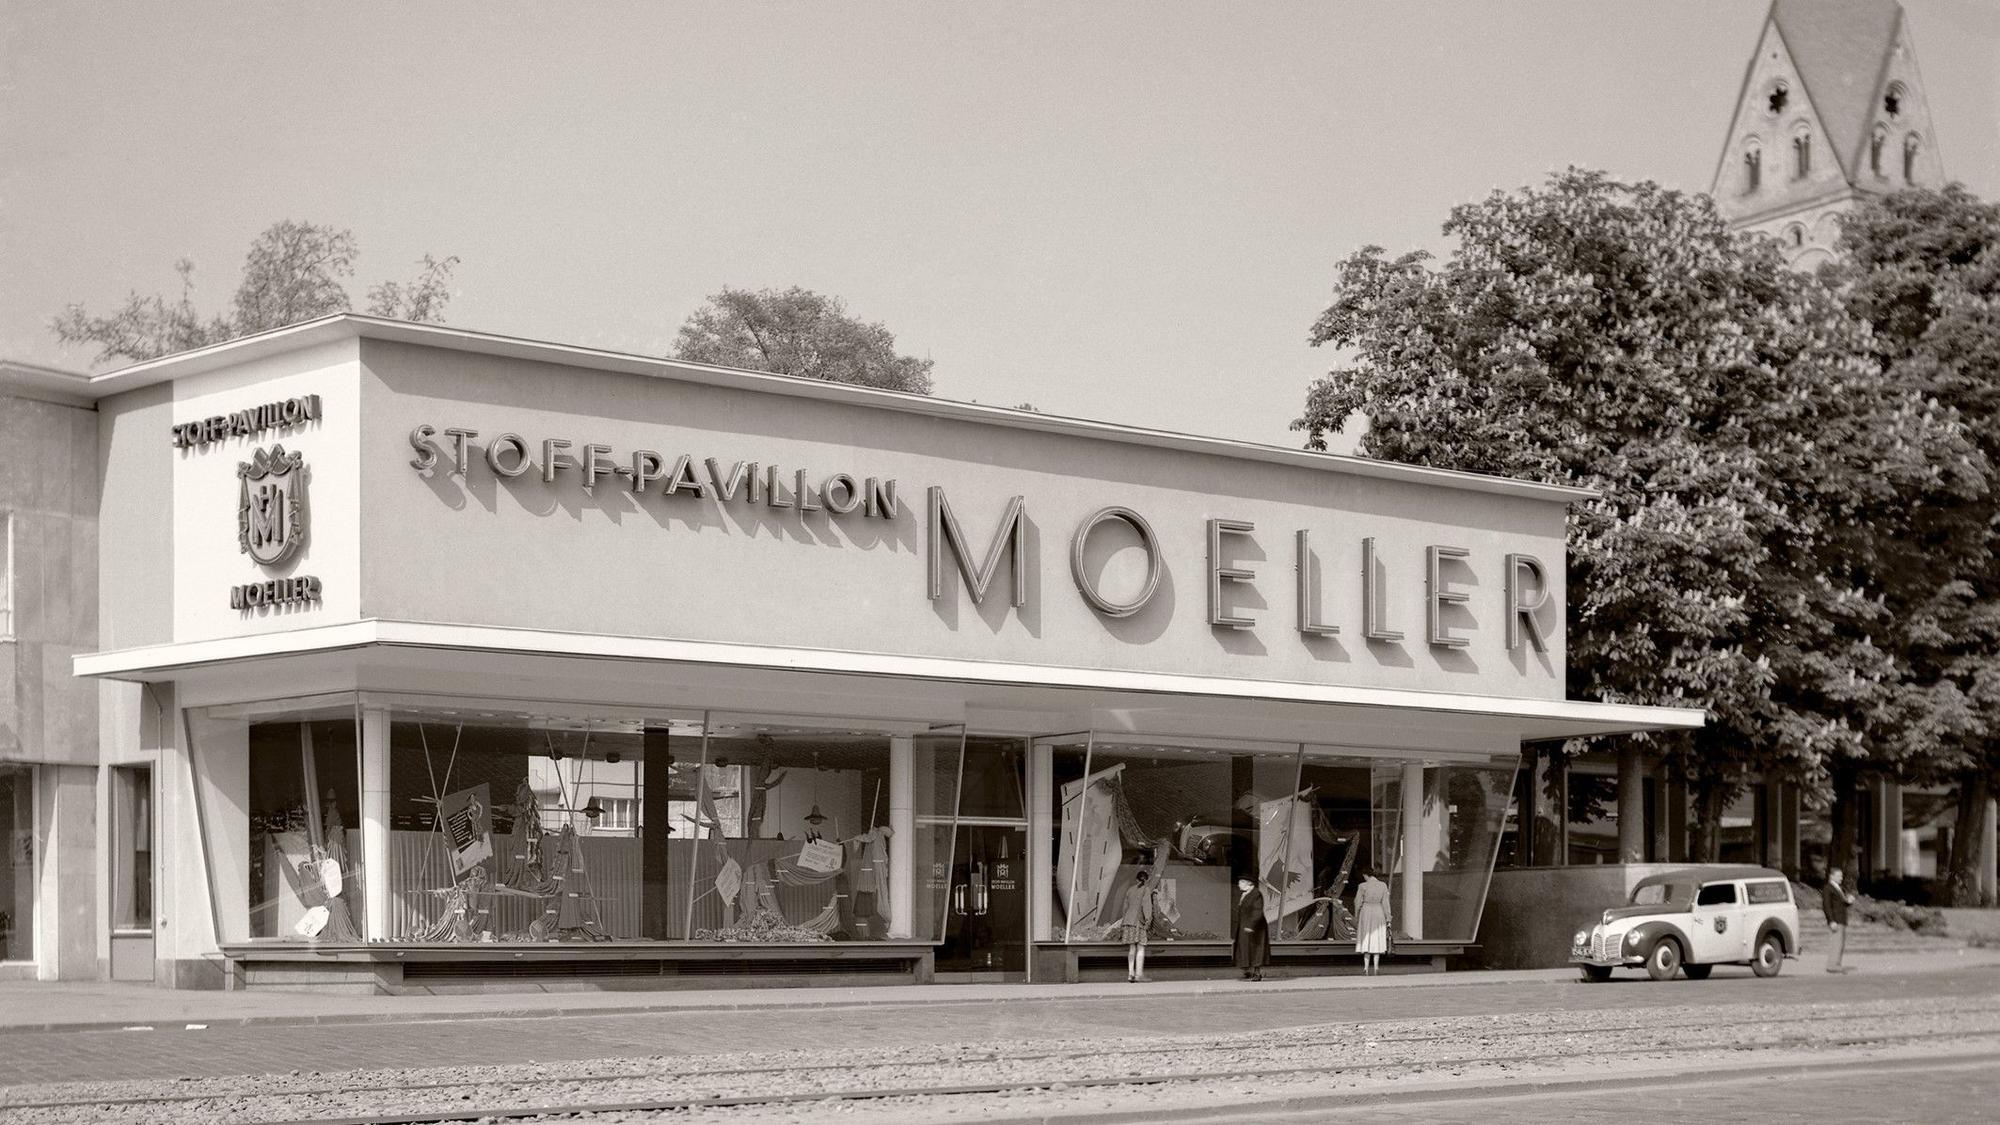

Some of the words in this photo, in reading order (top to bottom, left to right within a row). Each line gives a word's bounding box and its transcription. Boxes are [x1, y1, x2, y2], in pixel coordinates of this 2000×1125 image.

[172, 394, 321, 448] STOFF-PAVILLON
[409, 424, 899, 520] STOFF-PAVILLON
[927, 485, 1551, 653] MOELLER
[230, 575, 322, 610] MOELLER
